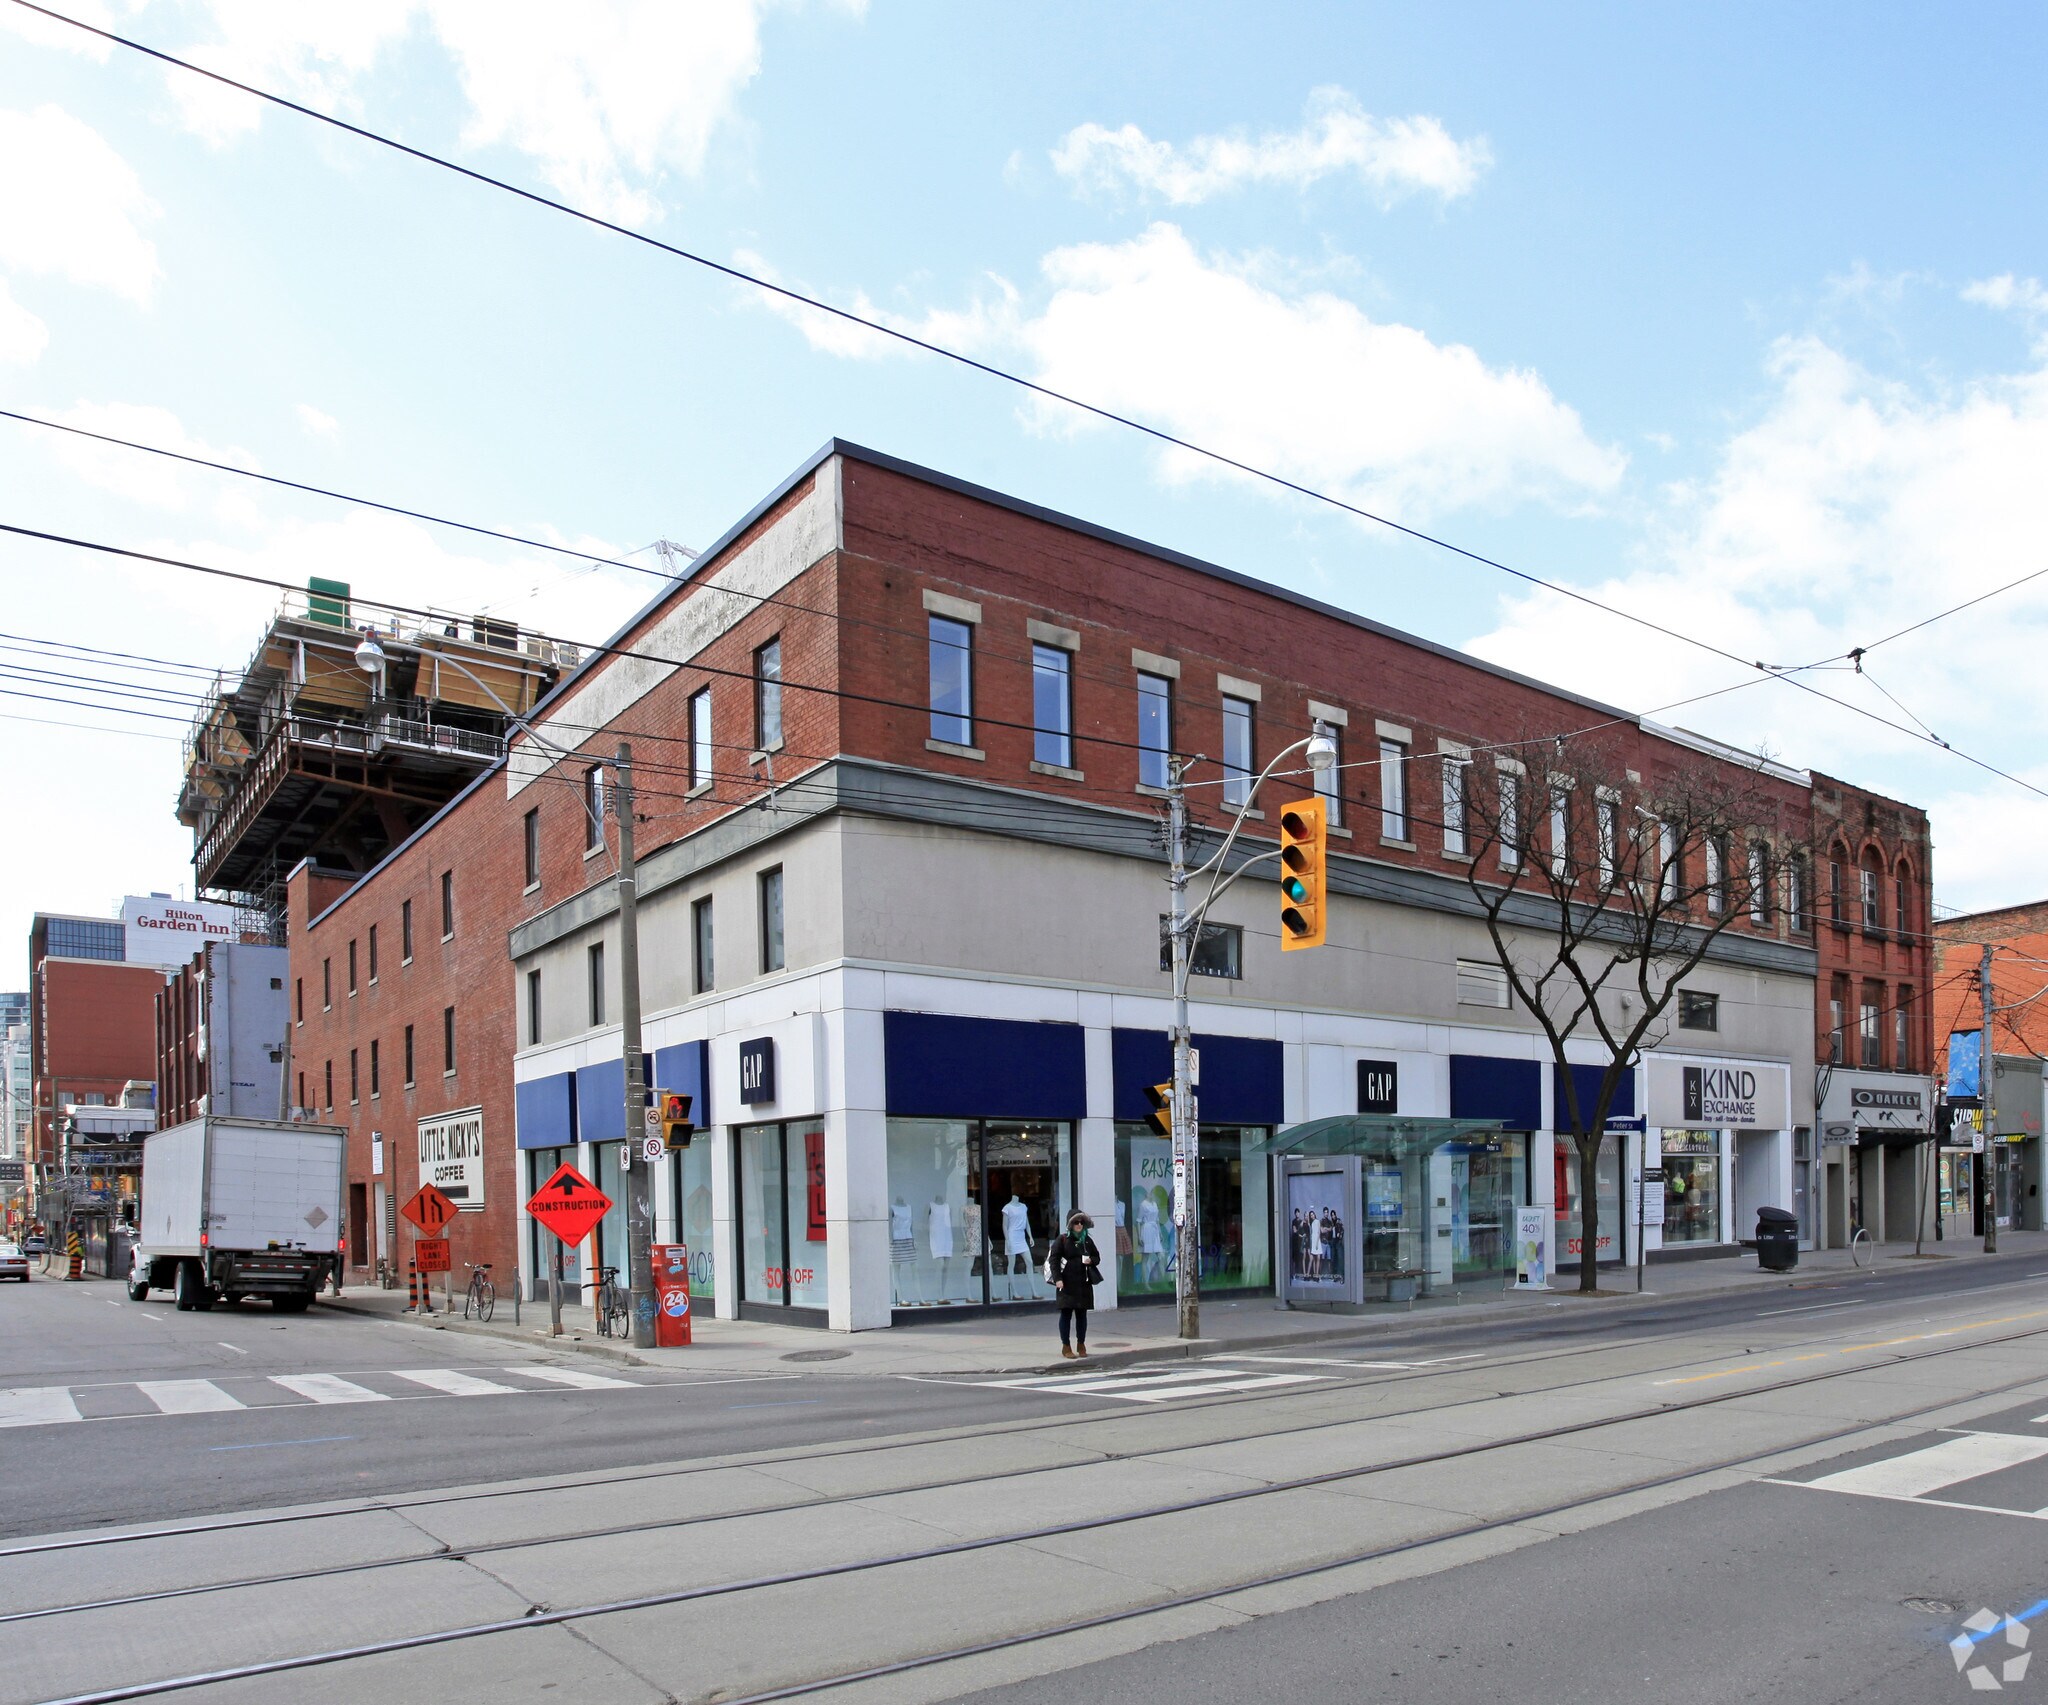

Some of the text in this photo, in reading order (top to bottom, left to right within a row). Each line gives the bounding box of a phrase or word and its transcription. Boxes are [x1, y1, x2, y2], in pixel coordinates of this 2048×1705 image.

[165, 909, 203, 920] Hilton
[137, 915, 230, 934] Garden Inn
[743, 1053, 762, 1090] GAP
[1368, 1072, 1392, 1101] GAP
[1703, 1068, 1756, 1100] KIND
[1875, 1093, 1919, 1105] OAKLEY
[1703, 1100, 1756, 1115] EXCHANGE
[1612, 1121, 1629, 1130] Peter
[420, 1126, 445, 1163] LITTLE
[448, 1120, 480, 1160] NICKY'S
[1993, 1134, 2026, 1143] SUBWAY
[434, 1164, 465, 1182] COFFEE
[1140, 1158, 1175, 1179] BASK
[531, 1199, 606, 1213] CONSTRUCTION
[420, 1242, 443, 1250] RIGHT
[423, 1251, 441, 1259] LANE
[420, 1260, 447, 1269] CLOSED
[794, 1268, 814, 1285] OFF
[666, 1293, 685, 1307] 24
